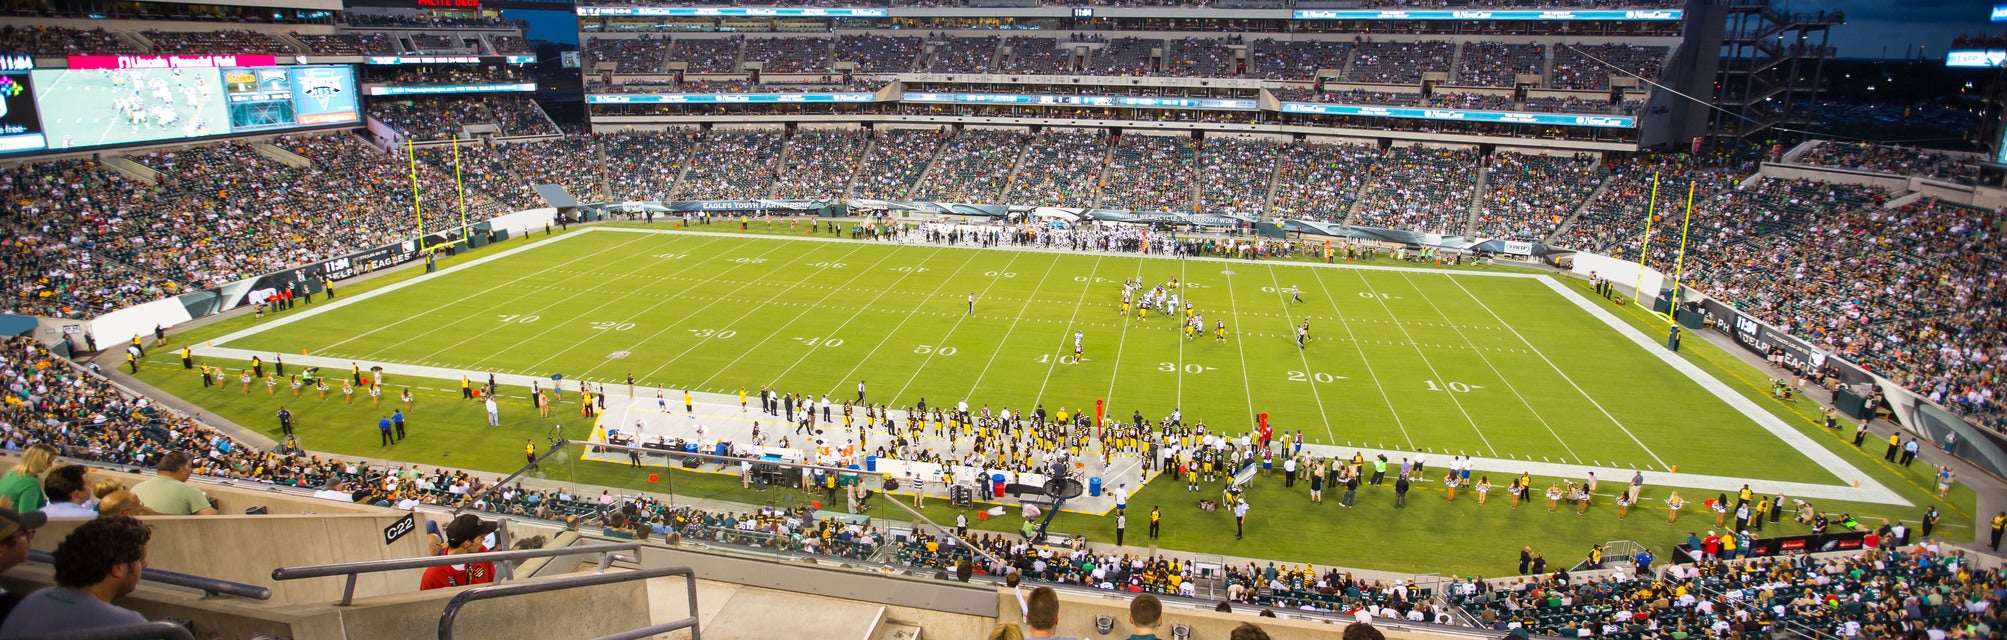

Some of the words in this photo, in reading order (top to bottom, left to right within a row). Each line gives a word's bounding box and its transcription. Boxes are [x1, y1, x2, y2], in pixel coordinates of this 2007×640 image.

[214, 56, 237, 66] Field
[913, 344, 958, 357] 50
[1158, 362, 1203, 374] 30
[1287, 370, 1334, 384] 20
[1423, 380, 1470, 393] 10
[387, 518, 414, 540] C22
